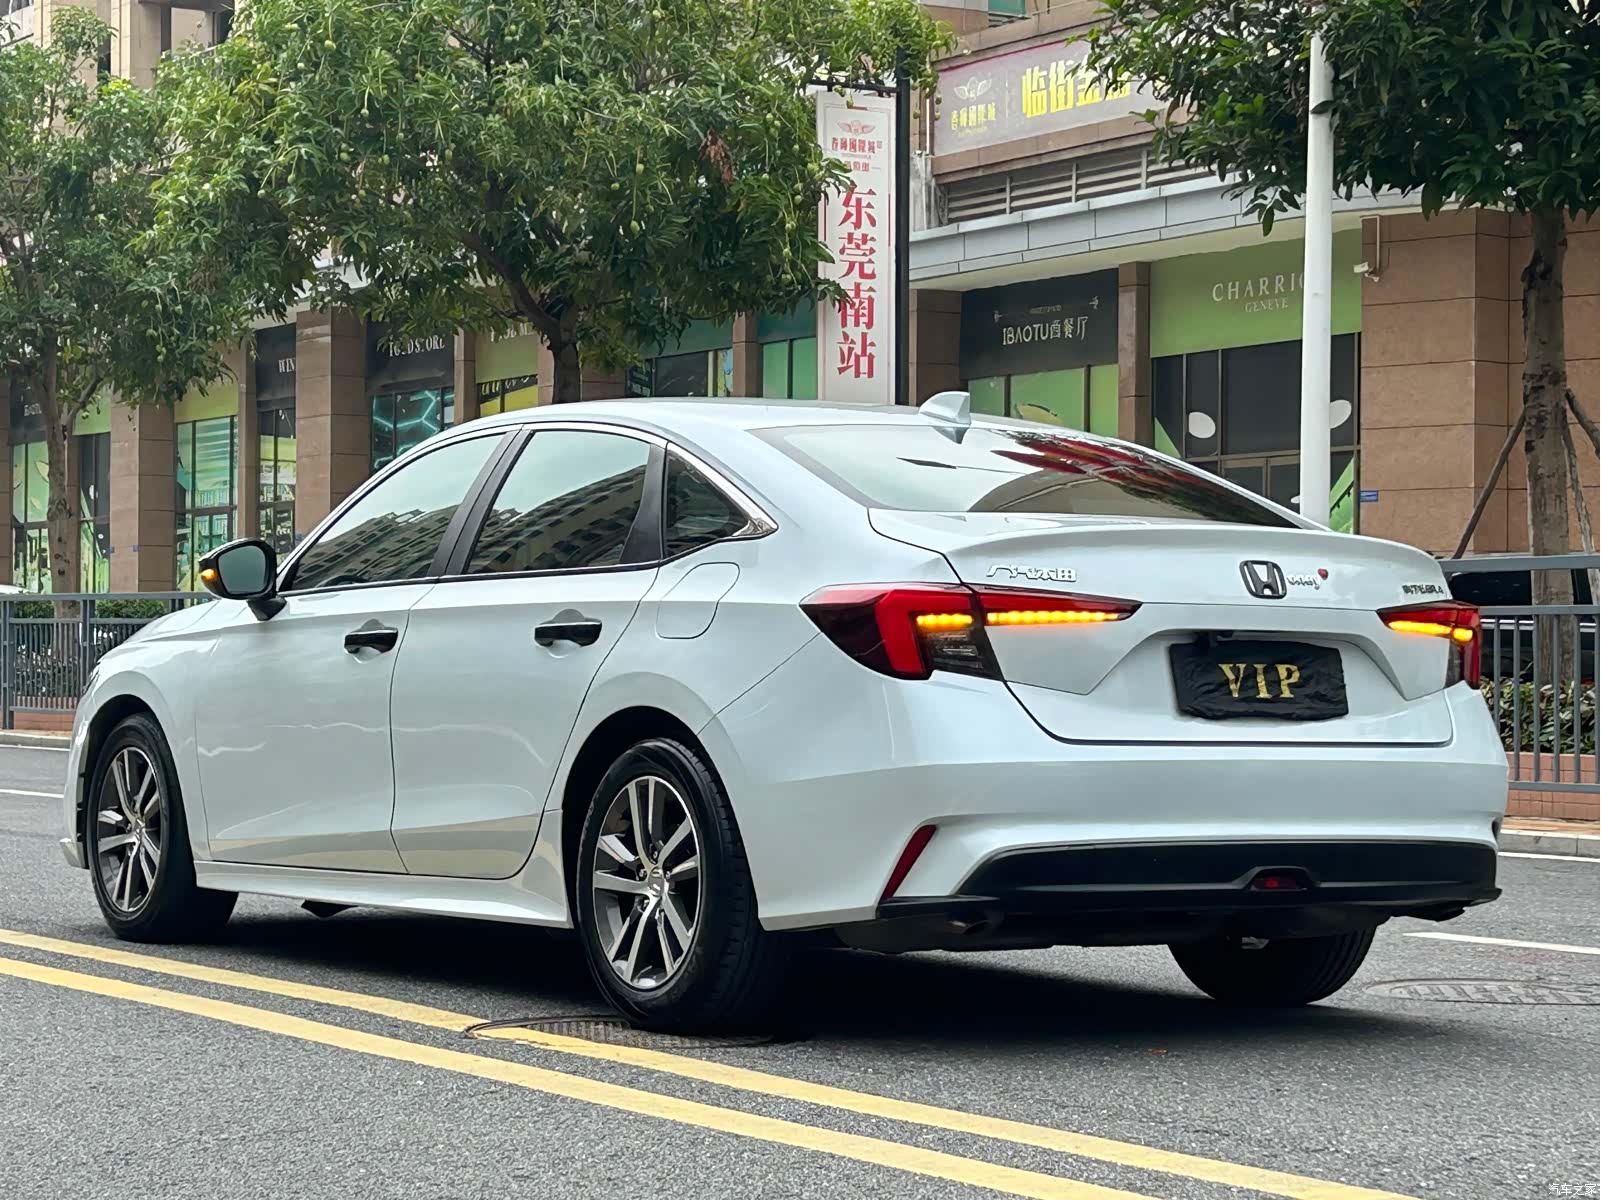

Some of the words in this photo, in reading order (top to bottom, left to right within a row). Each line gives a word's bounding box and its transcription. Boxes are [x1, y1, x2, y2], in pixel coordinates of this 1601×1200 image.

[837, 186, 877, 379] 东莞南站
[1245, 298, 1288, 312] GENEVE
[986, 564, 1077, 582] 广汽本田
[1218, 663, 1300, 698] VIP
